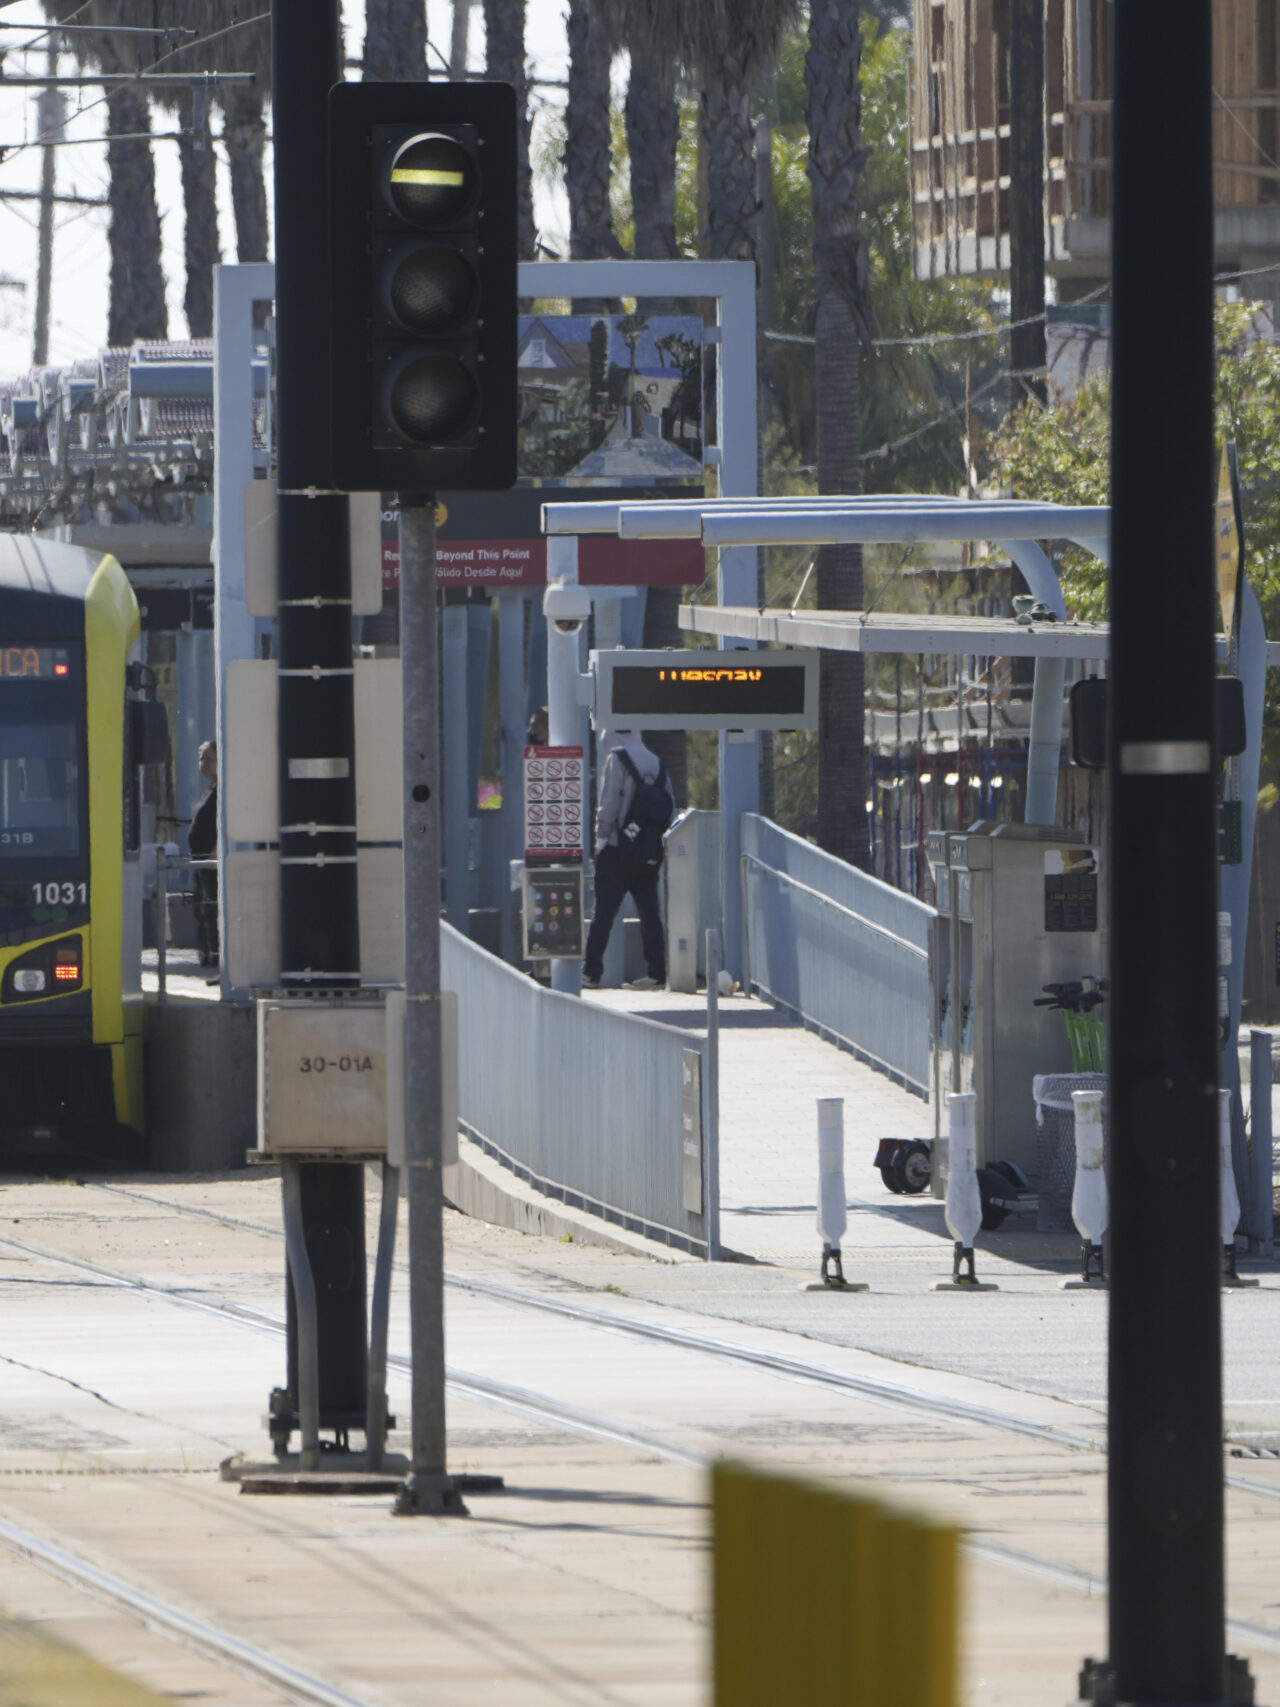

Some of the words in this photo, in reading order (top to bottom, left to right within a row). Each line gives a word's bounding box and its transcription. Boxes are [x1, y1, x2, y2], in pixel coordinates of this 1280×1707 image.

[436, 551, 474, 562] Beyond
[477, 549, 500, 560] This
[503, 549, 531, 560] Point
[464, 566, 496, 577] Desde
[32, 882, 88, 905] 1031
[299, 1055, 373, 1073] 30-01A
